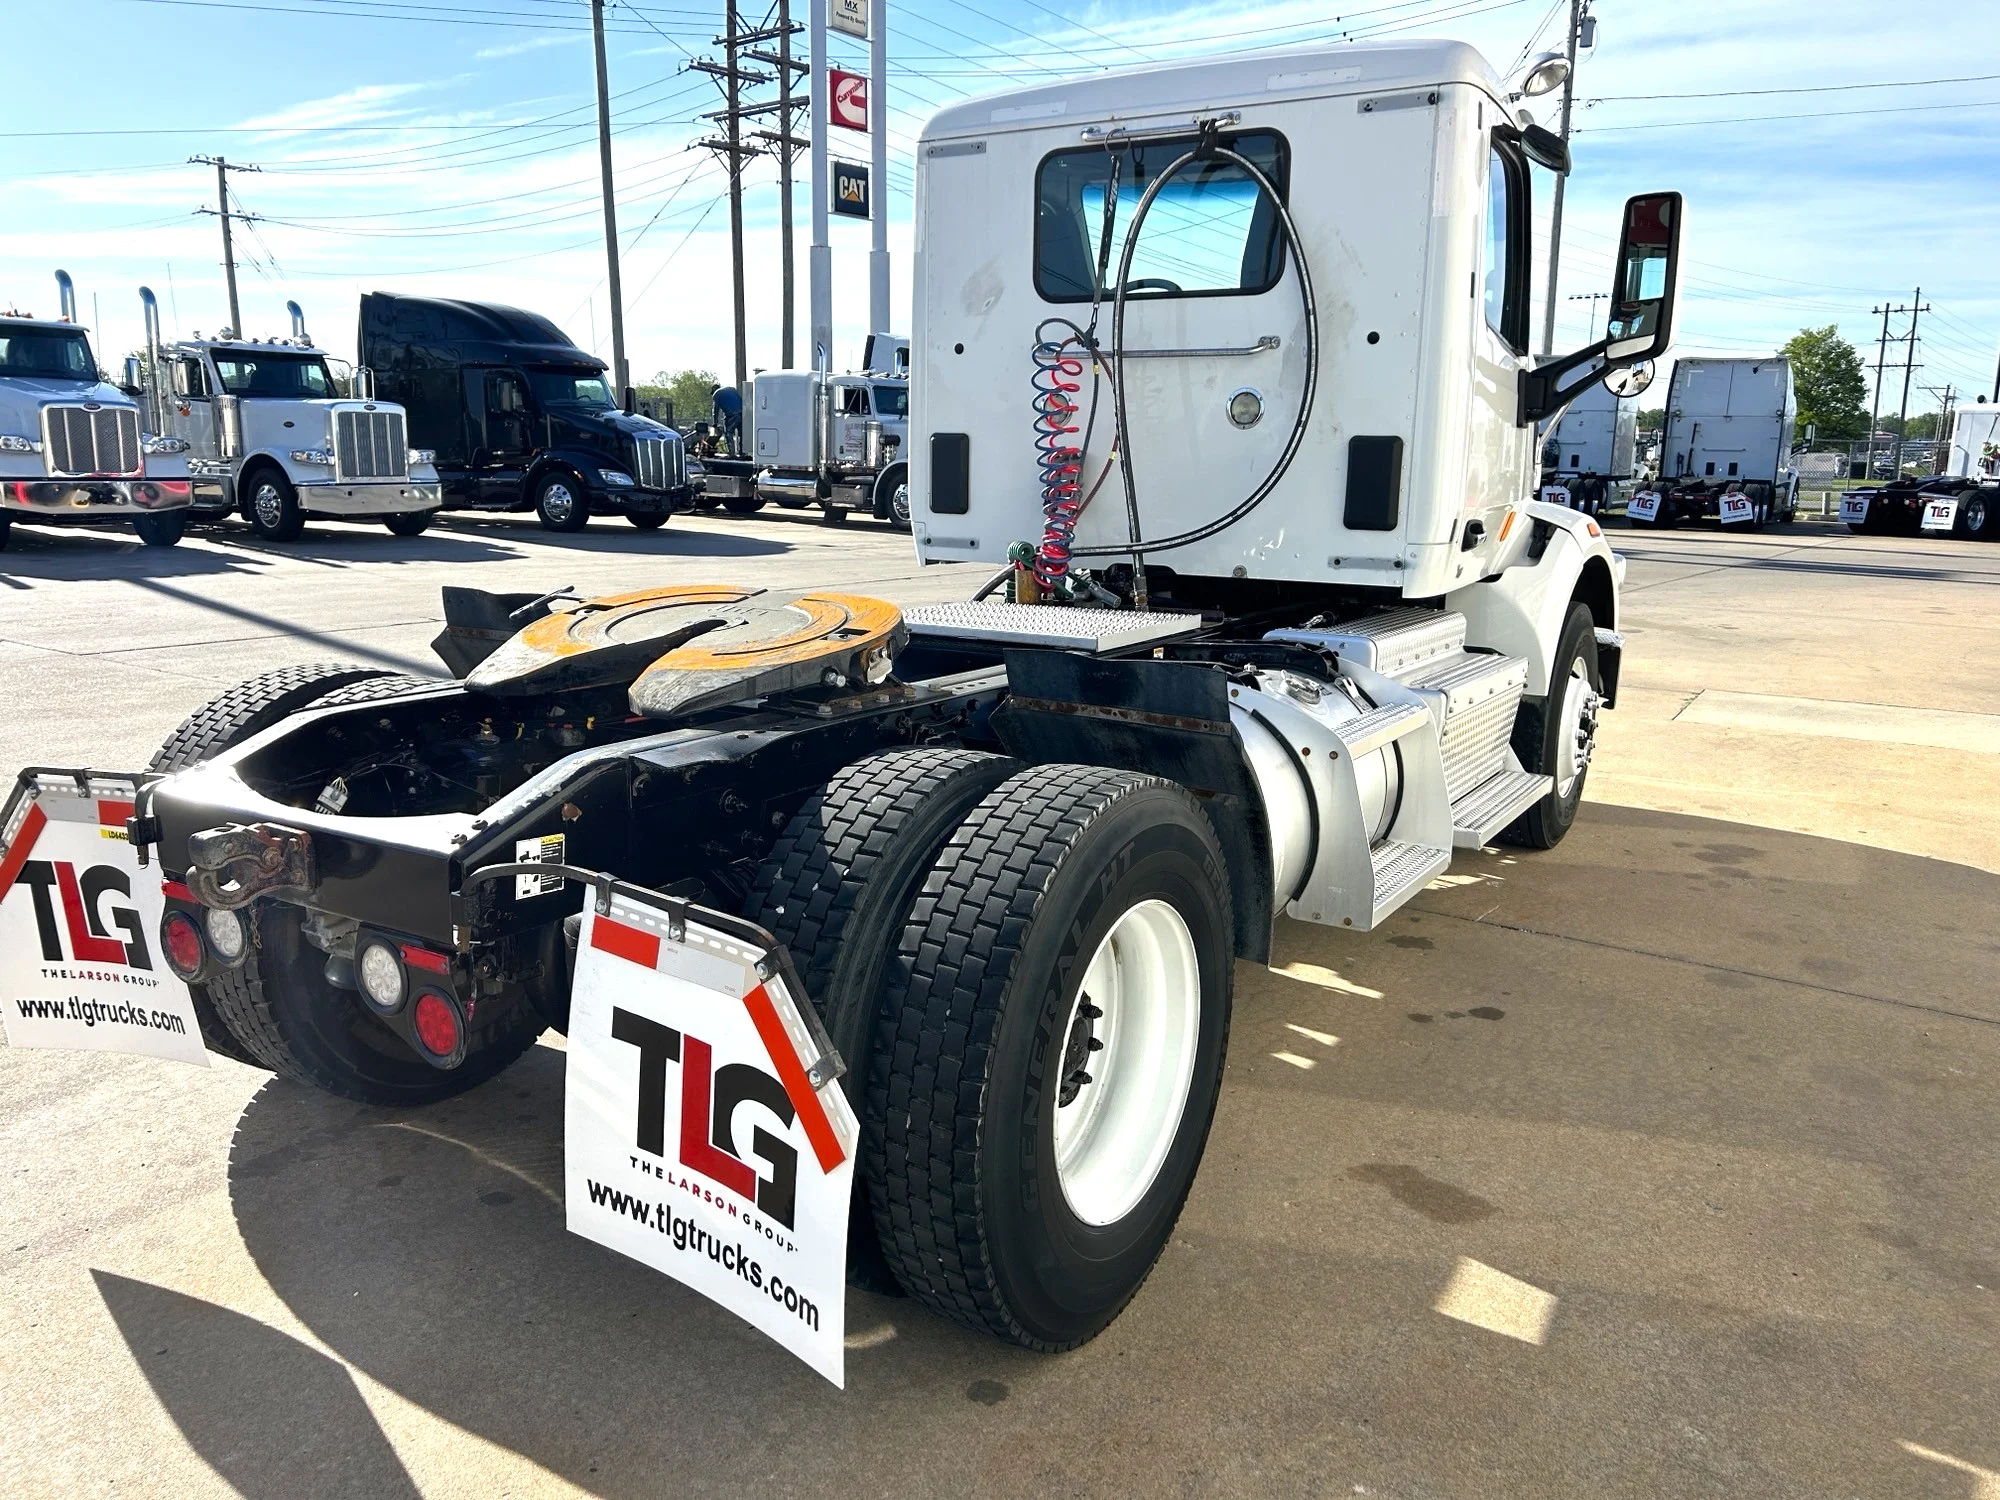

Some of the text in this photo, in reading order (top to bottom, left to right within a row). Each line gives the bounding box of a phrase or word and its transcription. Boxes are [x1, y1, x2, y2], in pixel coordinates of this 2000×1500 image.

[836, 11, 850, 21] Powered
[844, 0, 858, 11] MX
[837, 79, 864, 103] Cummins
[839, 175, 866, 204] CAT
[1546, 492, 1566, 503] TLG
[1635, 496, 1654, 510] TLG
[1724, 498, 1746, 512] TLG
[1845, 501, 1864, 513] TLG
[1930, 505, 1950, 518] TLG
[14, 860, 153, 972] TLG
[15, 995, 186, 1036] www.tlgtrucks.com
[1021, 918, 1090, 1214] GENERAL
[612, 1005, 798, 1233] TLG
[742, 1213, 794, 1253] GROUP
[587, 1178, 819, 1332] www.tlgtrucks.com
